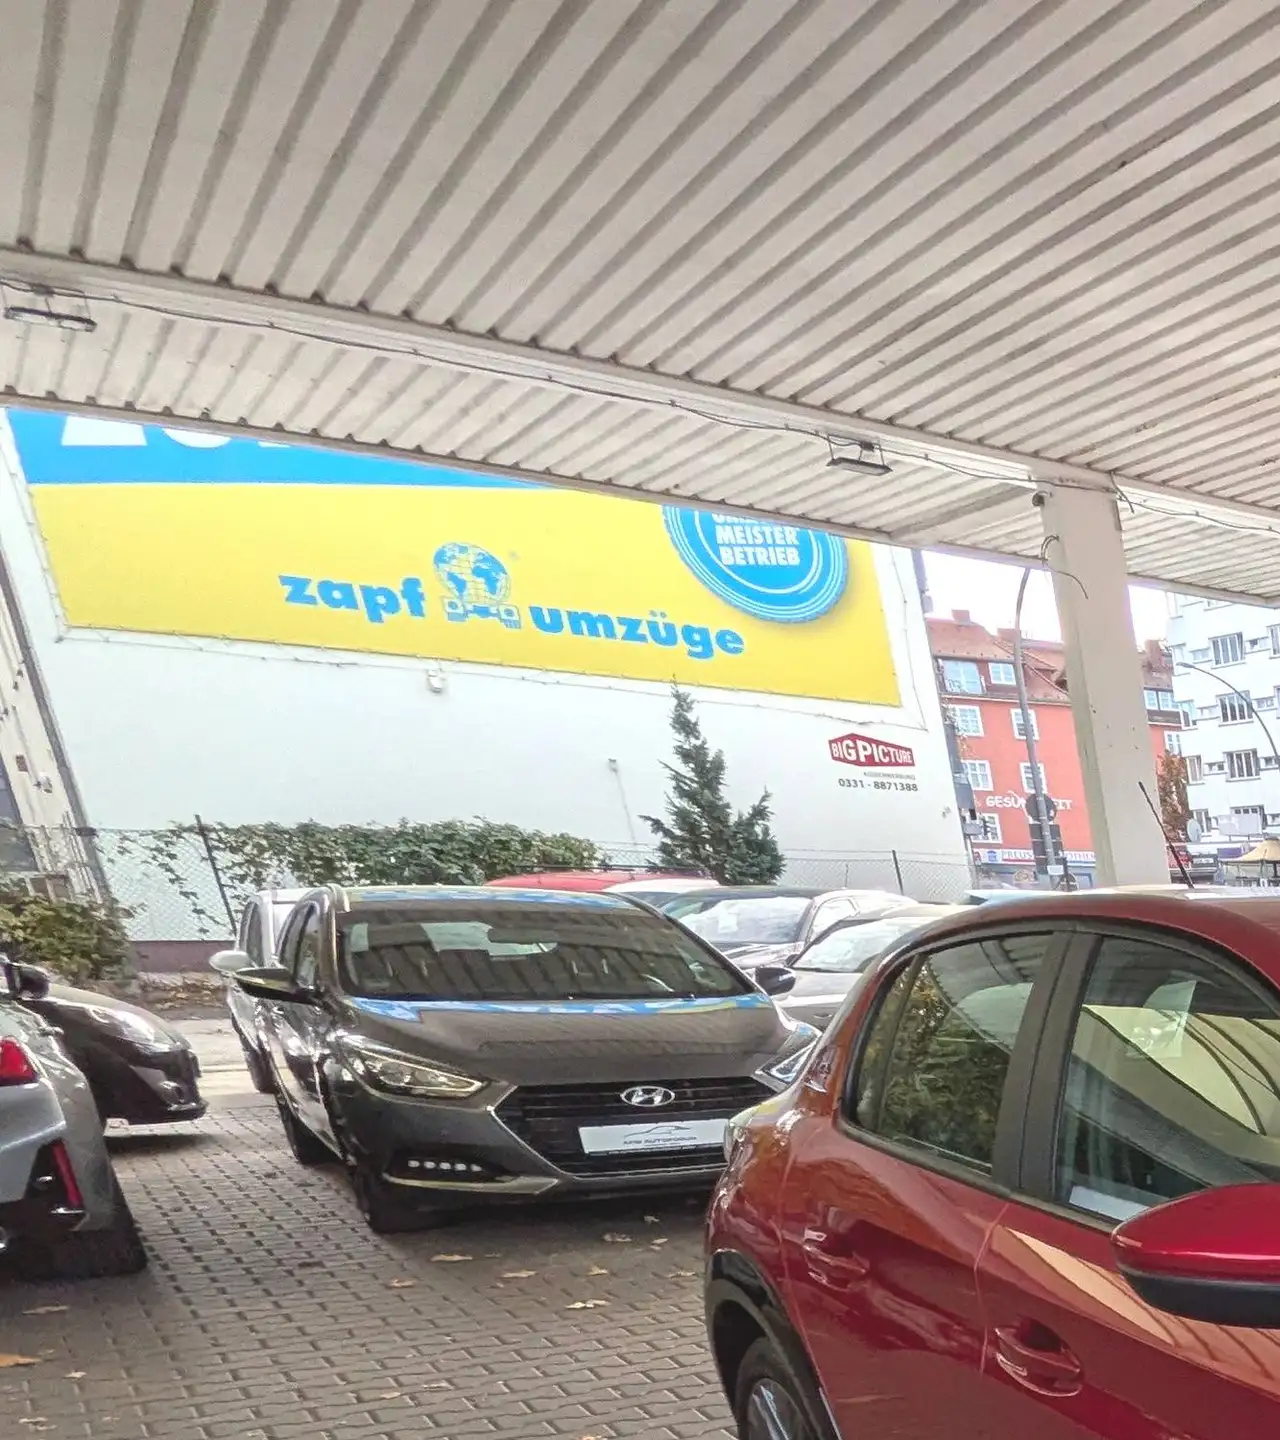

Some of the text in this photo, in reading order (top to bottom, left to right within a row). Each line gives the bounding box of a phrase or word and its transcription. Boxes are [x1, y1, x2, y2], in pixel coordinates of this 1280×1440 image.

[715, 525, 800, 545] MEISTER
[720, 546, 800, 566] BETRIEB
[279, 573, 745, 660] zapf umzüge
[838, 778, 865, 789] 0331
[873, 780, 918, 792] 8871388
